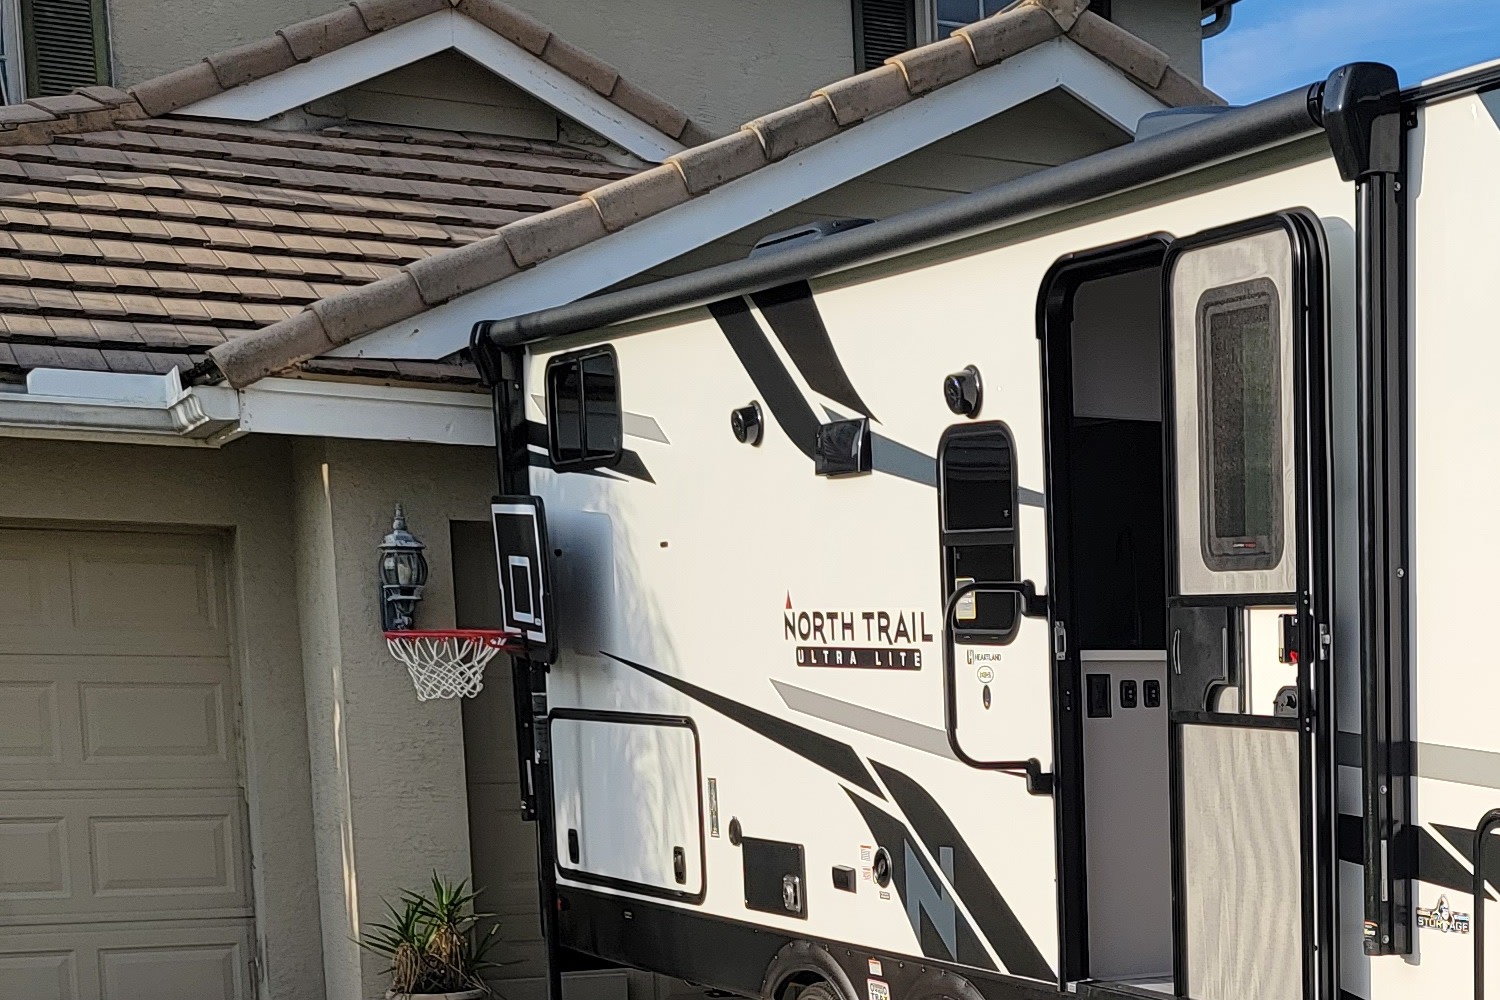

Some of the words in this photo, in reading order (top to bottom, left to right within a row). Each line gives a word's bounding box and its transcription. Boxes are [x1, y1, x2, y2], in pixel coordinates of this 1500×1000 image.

[783, 611, 855, 644] NORTH
[862, 610, 933, 645] TRAIL
[797, 649, 857, 665] ULTRA
[875, 650, 922, 667] LITE
